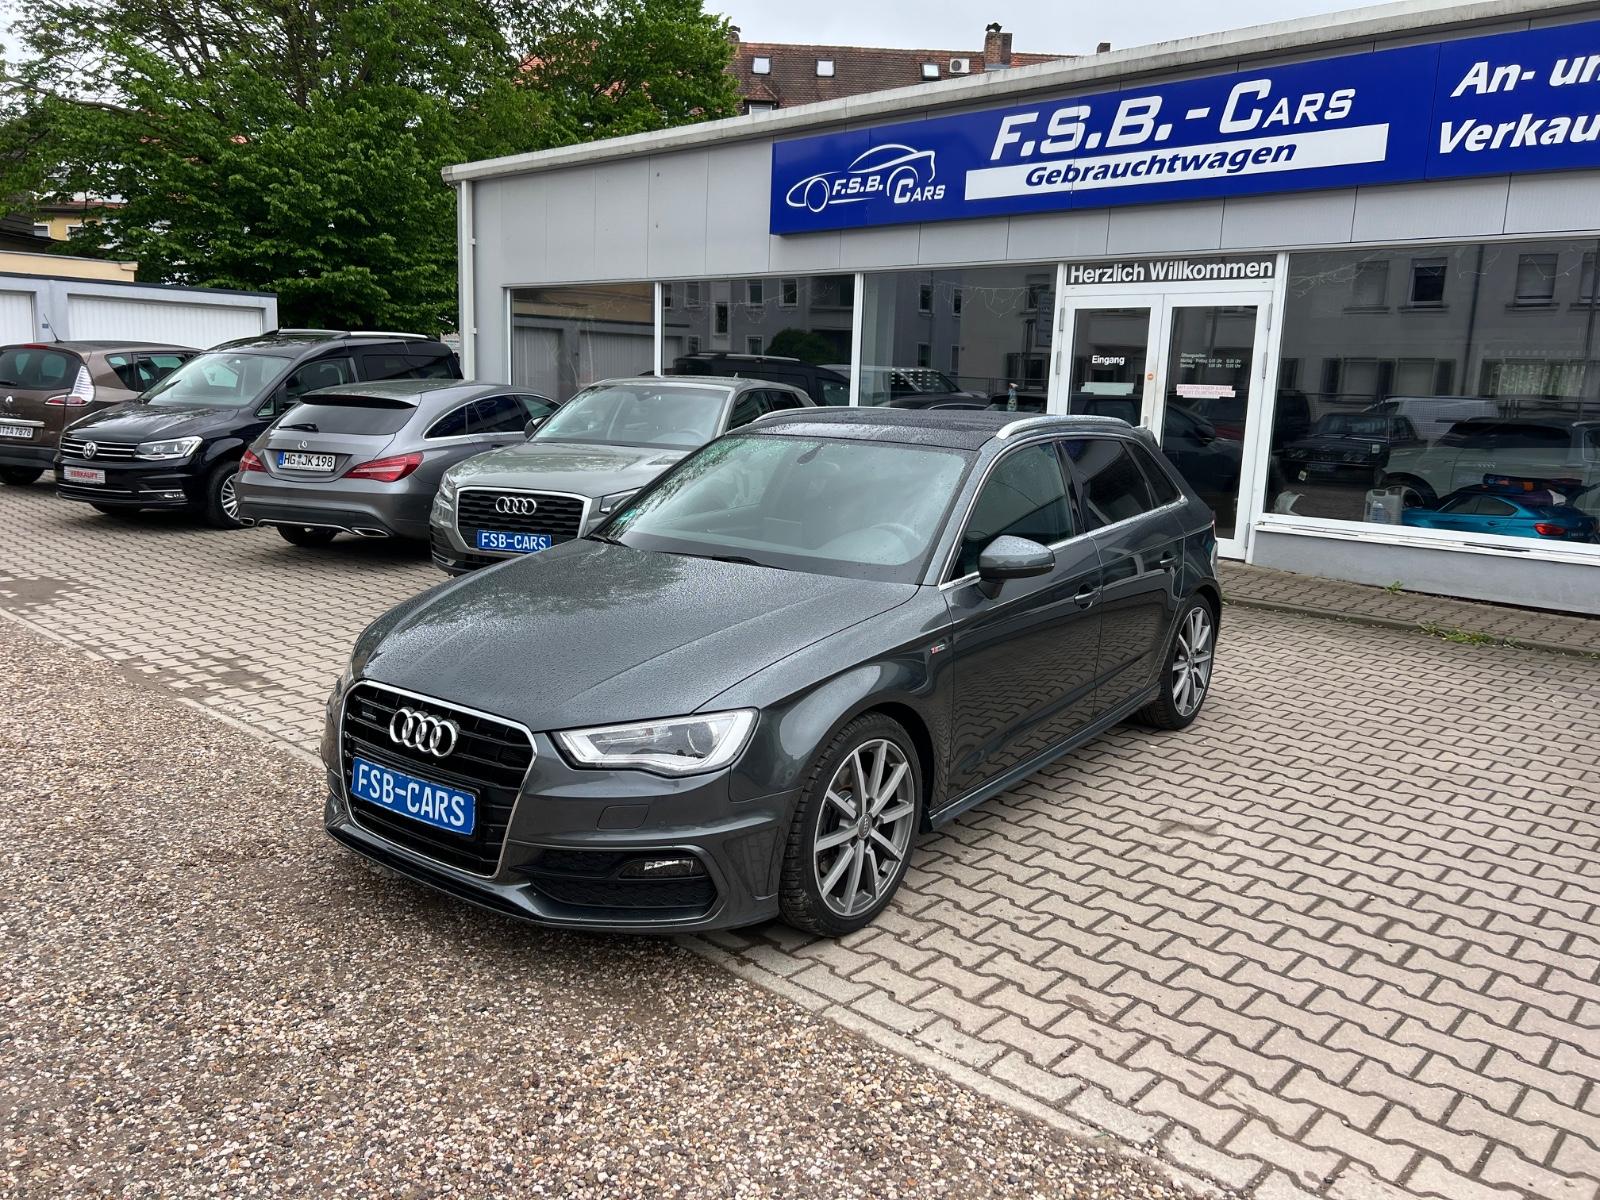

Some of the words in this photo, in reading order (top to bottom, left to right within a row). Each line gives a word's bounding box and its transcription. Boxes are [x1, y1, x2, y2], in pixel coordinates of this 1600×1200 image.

[1450, 61, 1536, 98] An-
[1439, 113, 1600, 154] Verkau
[1025, 141, 1298, 188] Gebrauchtwagen
[832, 175, 883, 196] F.S.B.
[1070, 264, 1145, 284] Herzlich
[1150, 261, 1273, 281] Willkommen
[1092, 355, 1125, 366] Eingang
[481, 532, 546, 551] FSB-CARS
[357, 763, 465, 827] FSB-CARS
